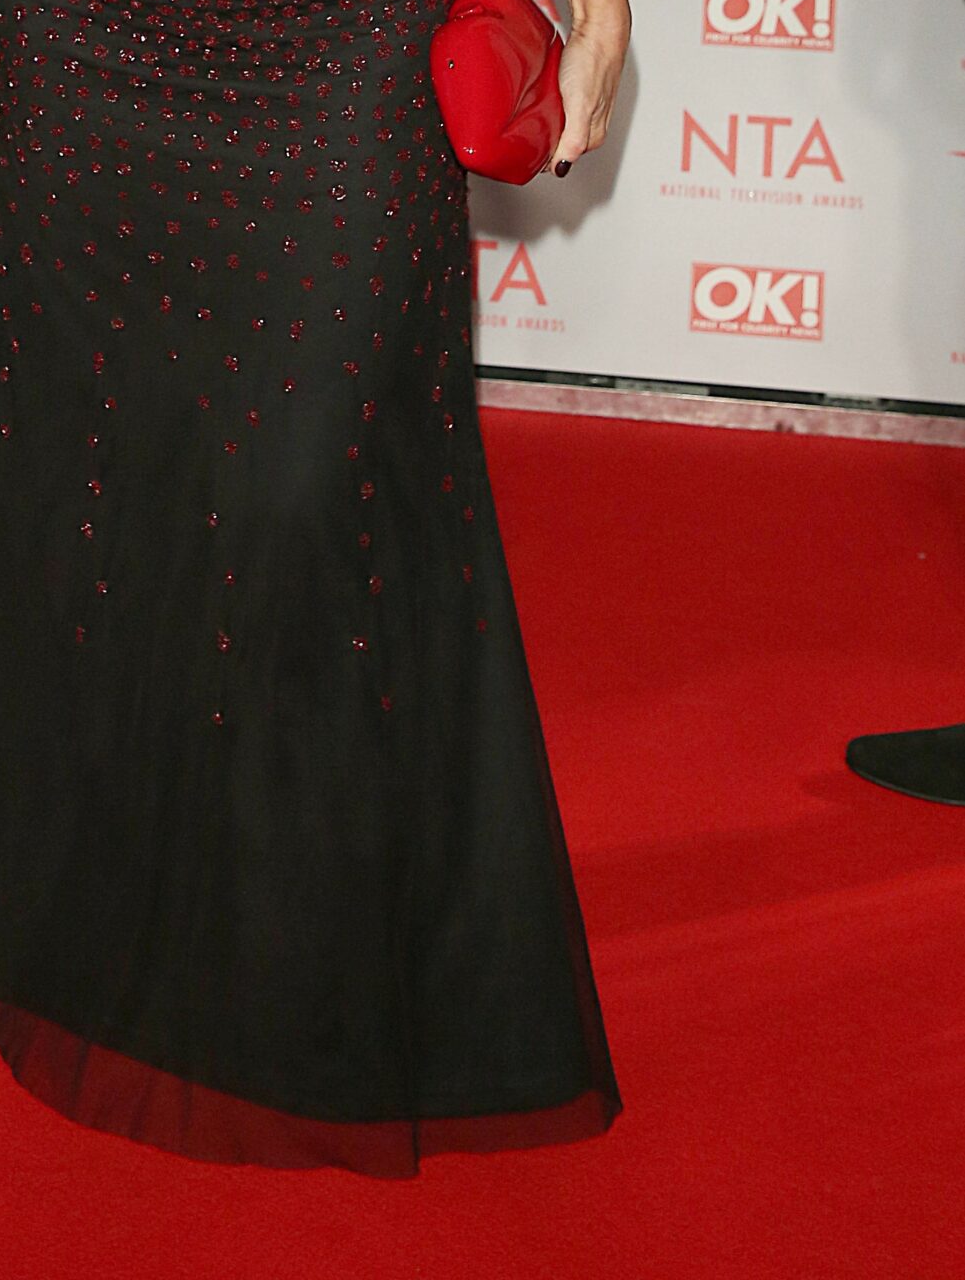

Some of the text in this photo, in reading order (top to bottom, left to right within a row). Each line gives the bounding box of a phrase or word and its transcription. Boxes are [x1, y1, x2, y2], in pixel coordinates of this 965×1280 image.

[681, 108, 844, 183] NTA
[660, 183, 864, 209] NATIONAL TELEVISION AWARDS
[694, 266, 819, 328] OK!
[517, 316, 565, 332] AWARDS
